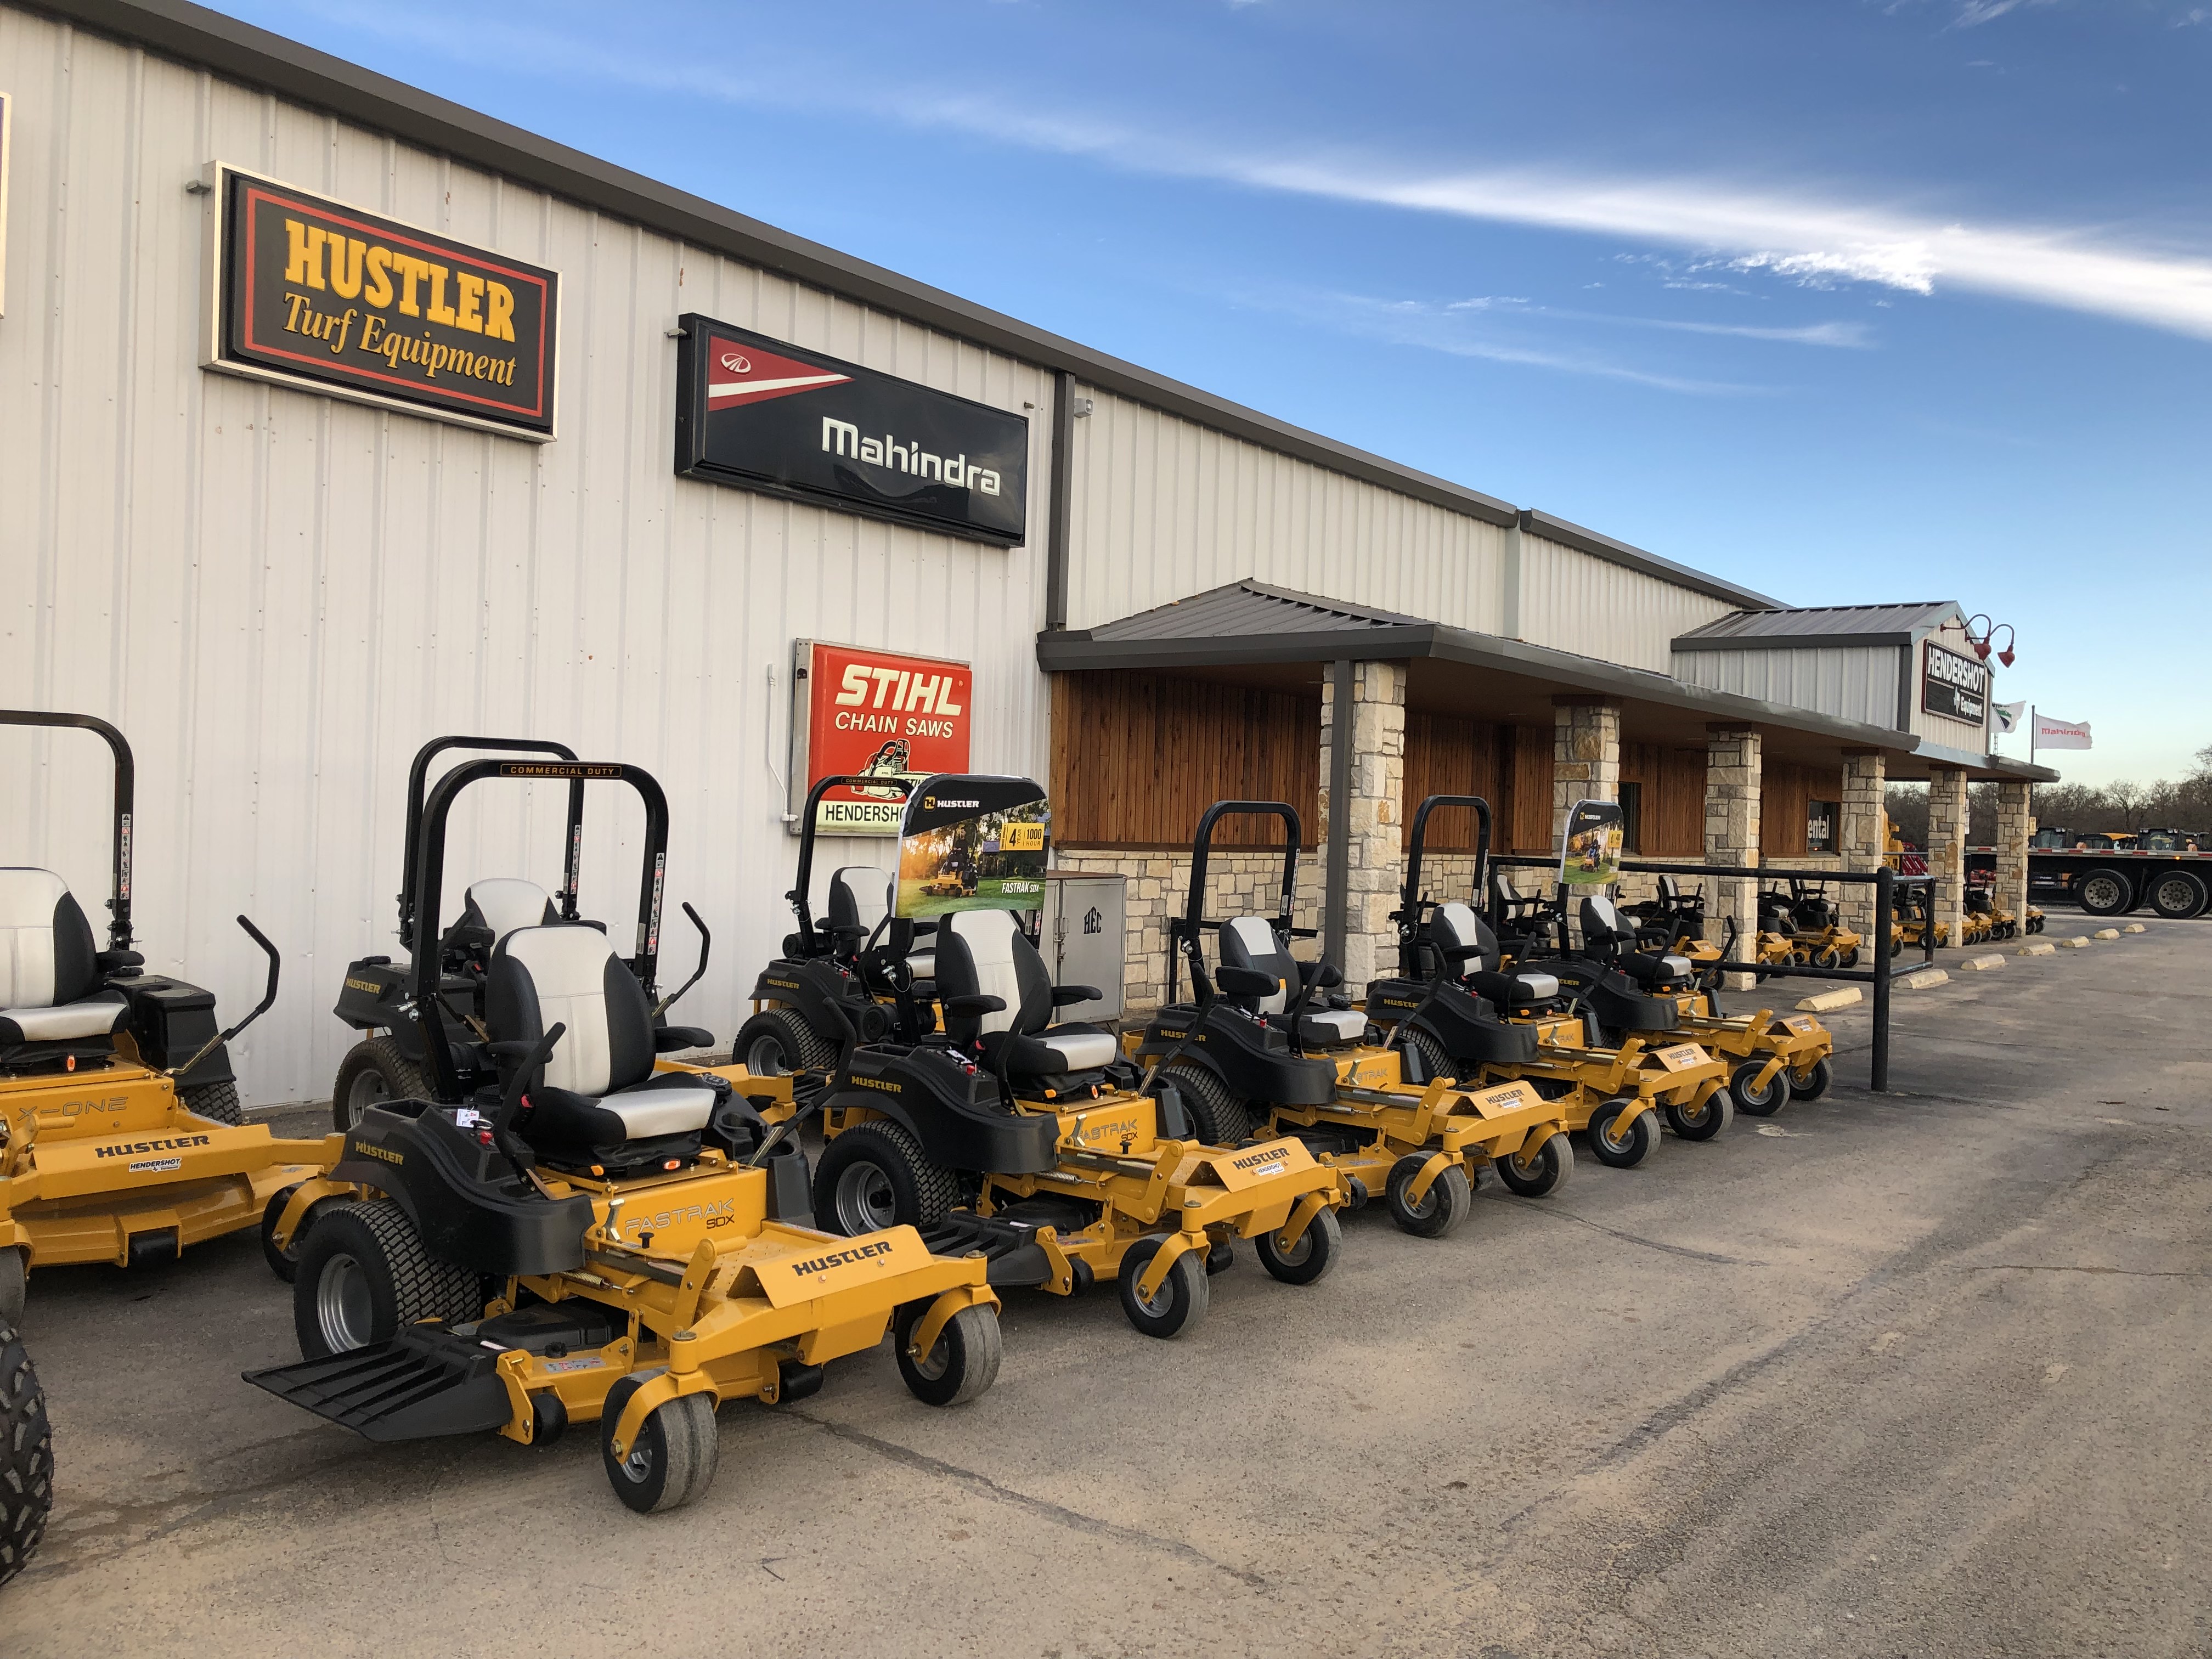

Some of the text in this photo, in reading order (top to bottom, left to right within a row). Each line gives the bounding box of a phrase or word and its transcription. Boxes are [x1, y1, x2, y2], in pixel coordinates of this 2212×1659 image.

[285, 218, 515, 342] HUSTLER
[283, 292, 517, 386] Turf Equipment
[823, 416, 1001, 496] Mahindra
[1927, 646, 1984, 693] HENDERSHOT
[835, 664, 962, 716] STIHL
[1961, 696, 1982, 718] Equipment
[835, 712, 953, 738] CHAIN SAWS
[511, 766, 582, 775] COMMERCIAL
[826, 805, 905, 822] HENDERSH
[937, 800, 980, 808] HUSTLER
[1027, 828, 1042, 840] 1000
[1808, 815, 1830, 839] ental
[1009, 828, 1017, 847] 4
[1002, 882, 1040, 894] FASTRAK SDX
[1084, 906, 1102, 934] HEC
[346, 978, 381, 994] HUSTLER
[767, 978, 799, 989] HUSTLER
[1384, 998, 1420, 1008] HUSTLE
[1160, 1029, 1206, 1042] HUSTR
[851, 1076, 902, 1093] HUSTLER
[1485, 1089, 1525, 1104] HUSTLER
[17, 1096, 128, 1121] X-ONE
[1080, 1118, 1138, 1141] ASTRAK
[1121, 1131, 1138, 1142] SDX
[95, 1135, 210, 1158] HUSTLER
[356, 1141, 403, 1165] HUSTLER
[130, 1158, 180, 1170] HENDERSHOT
[1232, 1147, 1290, 1170] HUSTLER
[1257, 1163, 1282, 1173] HENDERSHOT
[625, 1198, 734, 1235] FASTRAK
[706, 1214, 735, 1229] SDX
[792, 1241, 893, 1277] HUSTLER
